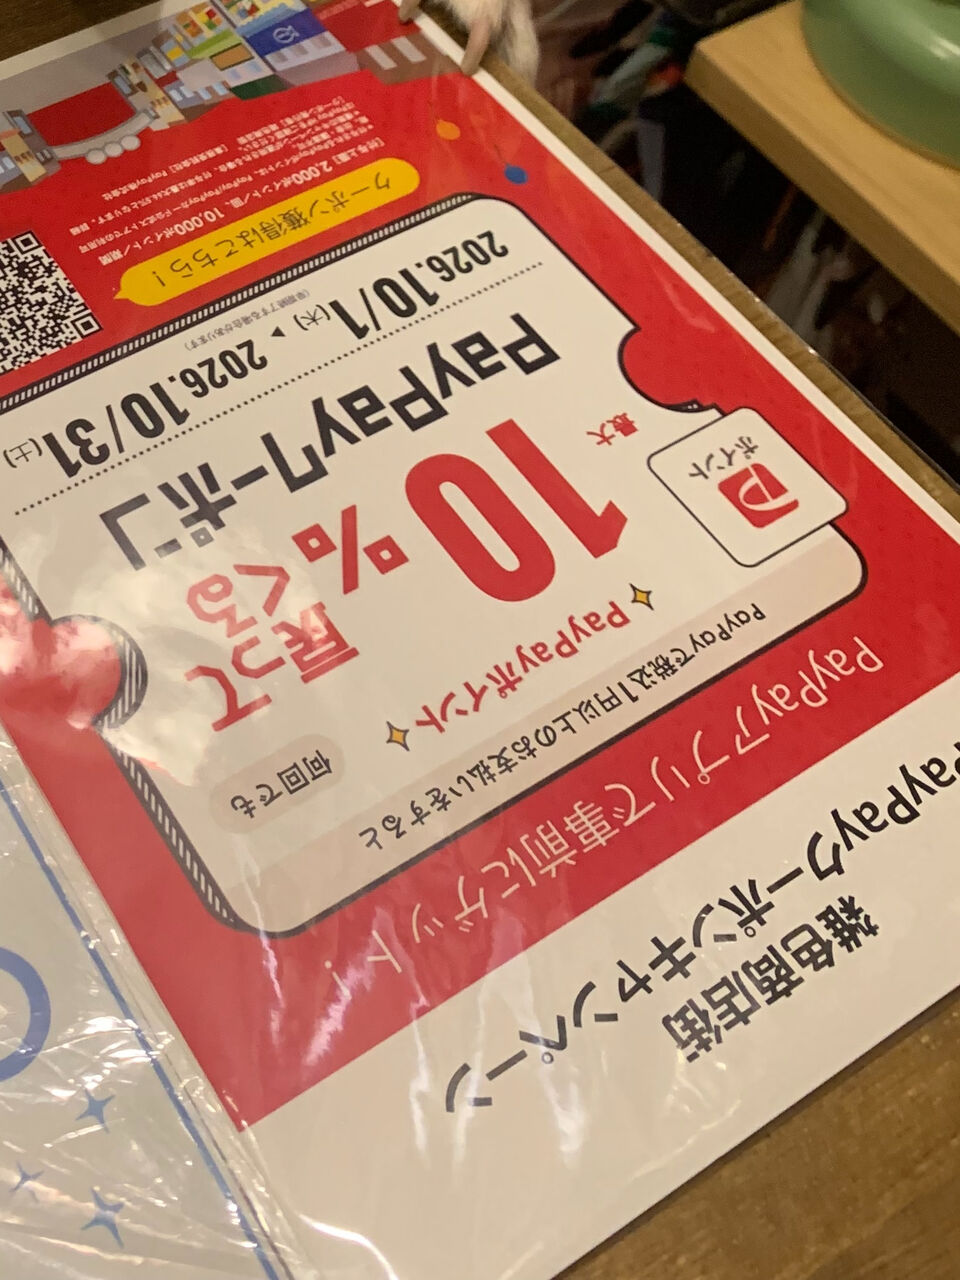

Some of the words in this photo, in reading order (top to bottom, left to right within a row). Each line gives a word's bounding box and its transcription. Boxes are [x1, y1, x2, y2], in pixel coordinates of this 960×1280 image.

[99, 313, 560, 567] PayPayクーポン
[587, 413, 638, 445] 最大
[689, 431, 765, 479] ポイント
[187, 564, 290, 637] くる
[183, 602, 360, 731] 戻って
[359, 603, 766, 849] PayPayで税込1円以上のお支払いをすると
[416, 601, 630, 733] PayPayポイント
[231, 750, 332, 818] 何回でも
[662, 896, 879, 1062] 雑色商店街
